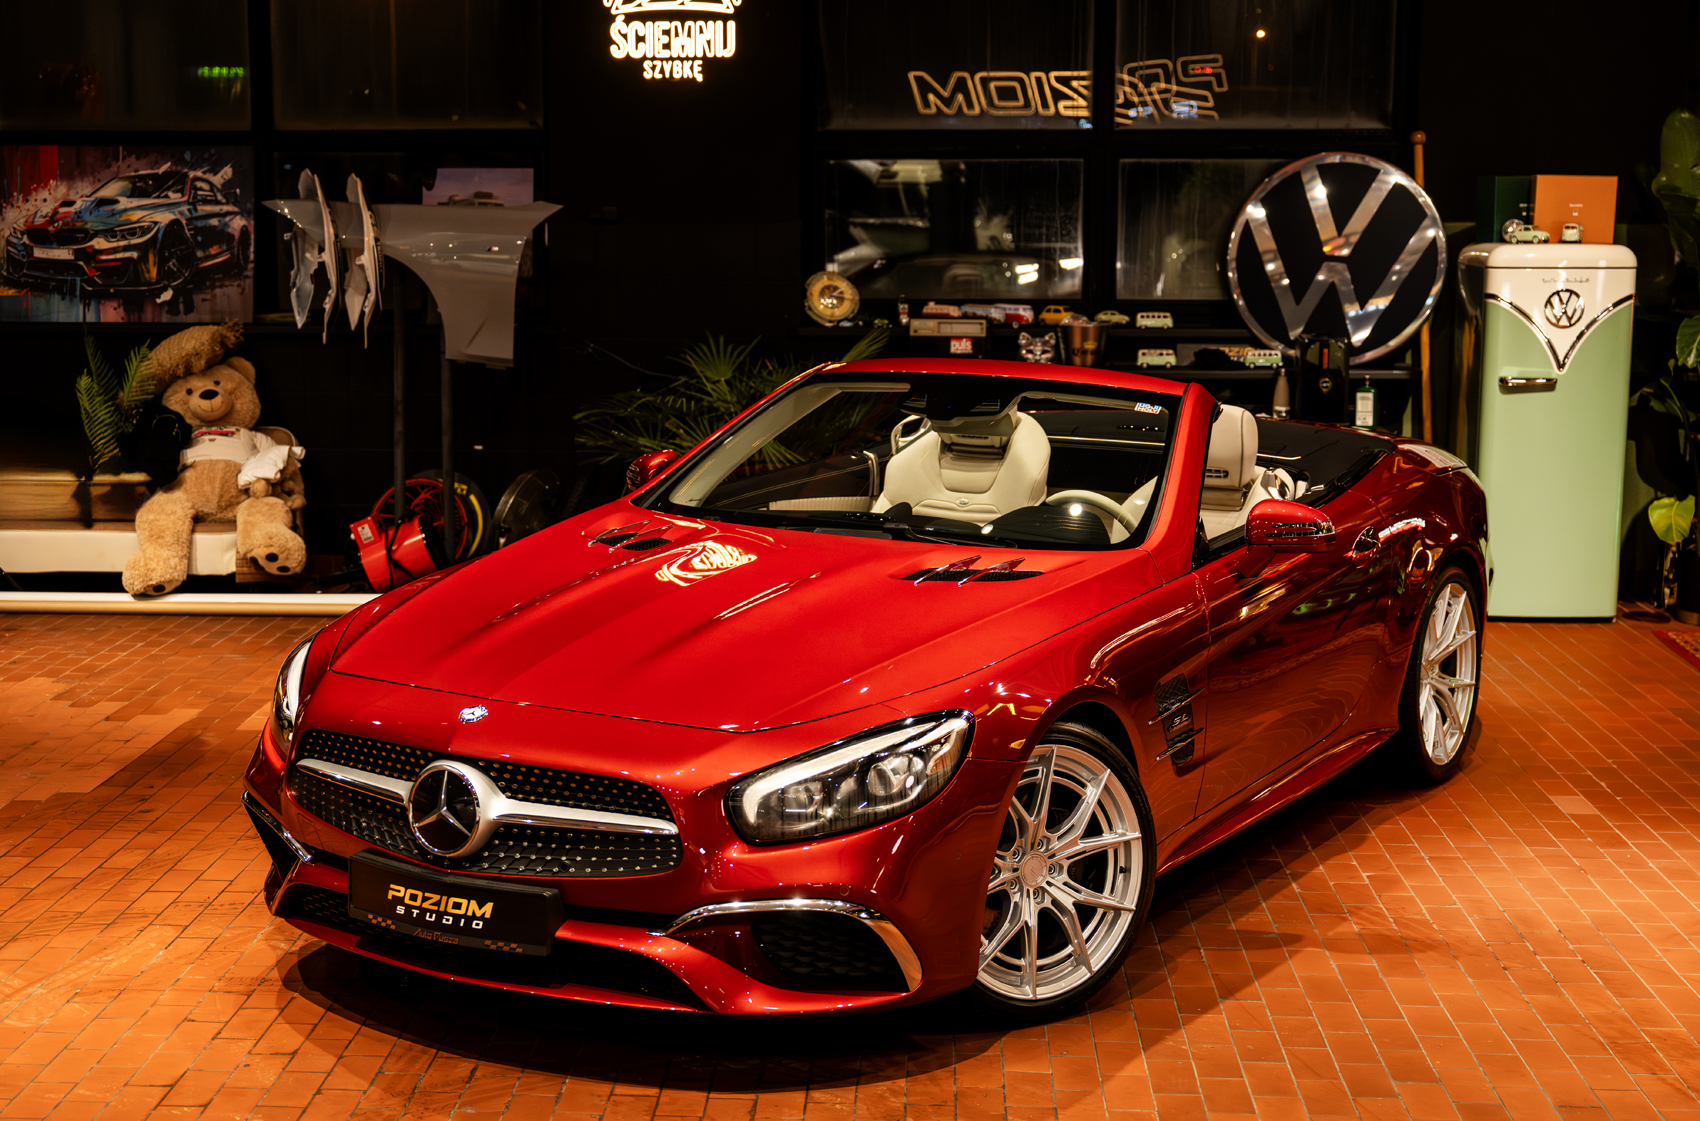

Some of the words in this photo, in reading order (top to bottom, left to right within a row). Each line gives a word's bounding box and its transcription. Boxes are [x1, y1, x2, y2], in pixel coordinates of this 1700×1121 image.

[643, 60, 704, 82] SZYBKĘ
[950, 338, 973, 352] puls
[387, 884, 494, 919] POZIOM
[396, 905, 484, 929] STUDIO
